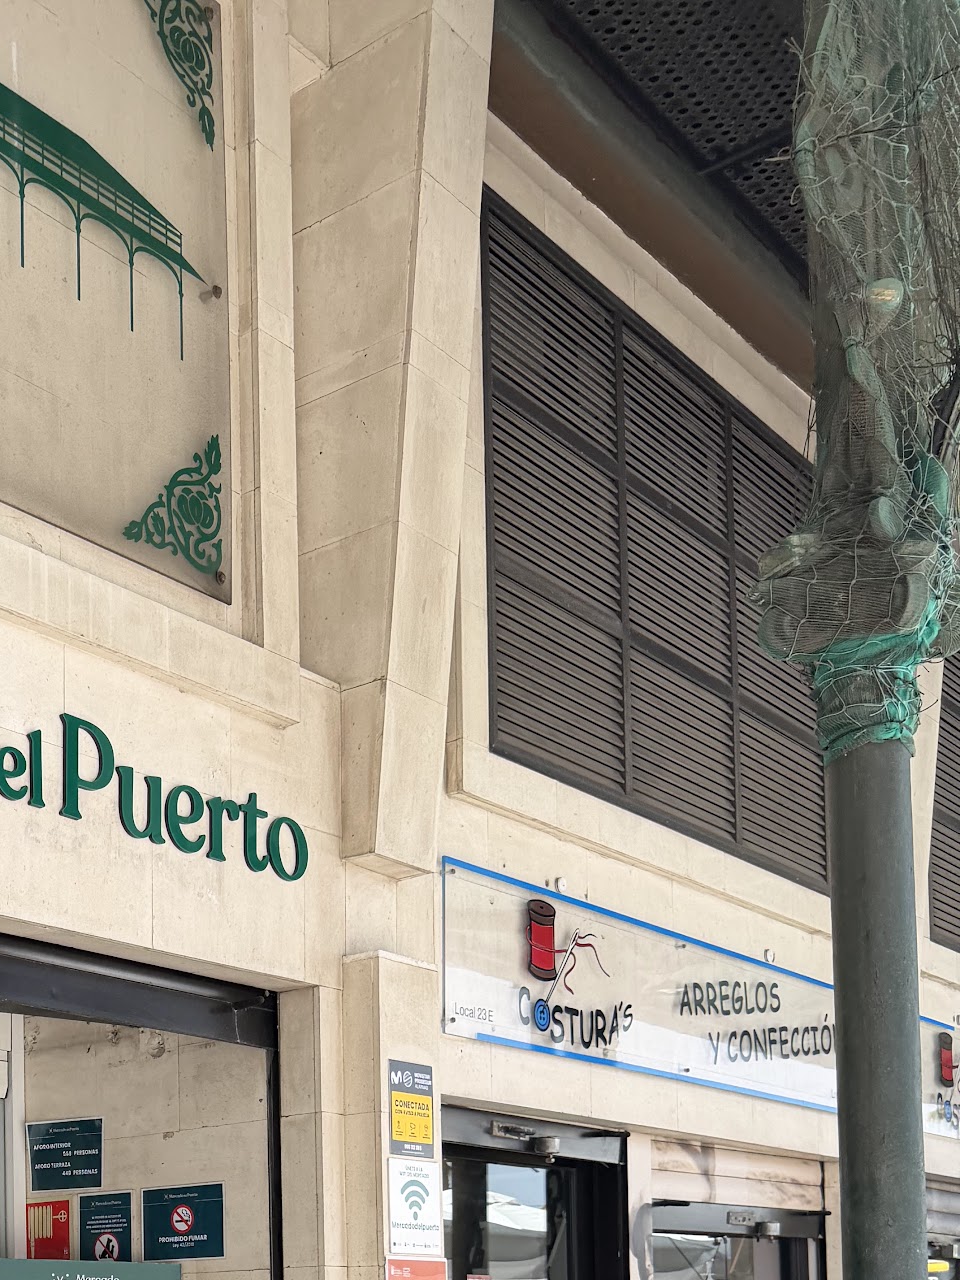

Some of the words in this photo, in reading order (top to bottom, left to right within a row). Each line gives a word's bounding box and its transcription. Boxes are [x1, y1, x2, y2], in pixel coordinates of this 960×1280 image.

[58, 712, 309, 883] Puerto
[454, 1002, 476, 1019] Local
[679, 981, 781, 1016] ARREGLOS
[708, 1031, 721, 1065] Y
[394, 1099, 430, 1111] CONECTADA
[159, 1235, 188, 1243] PROHIBIDO
